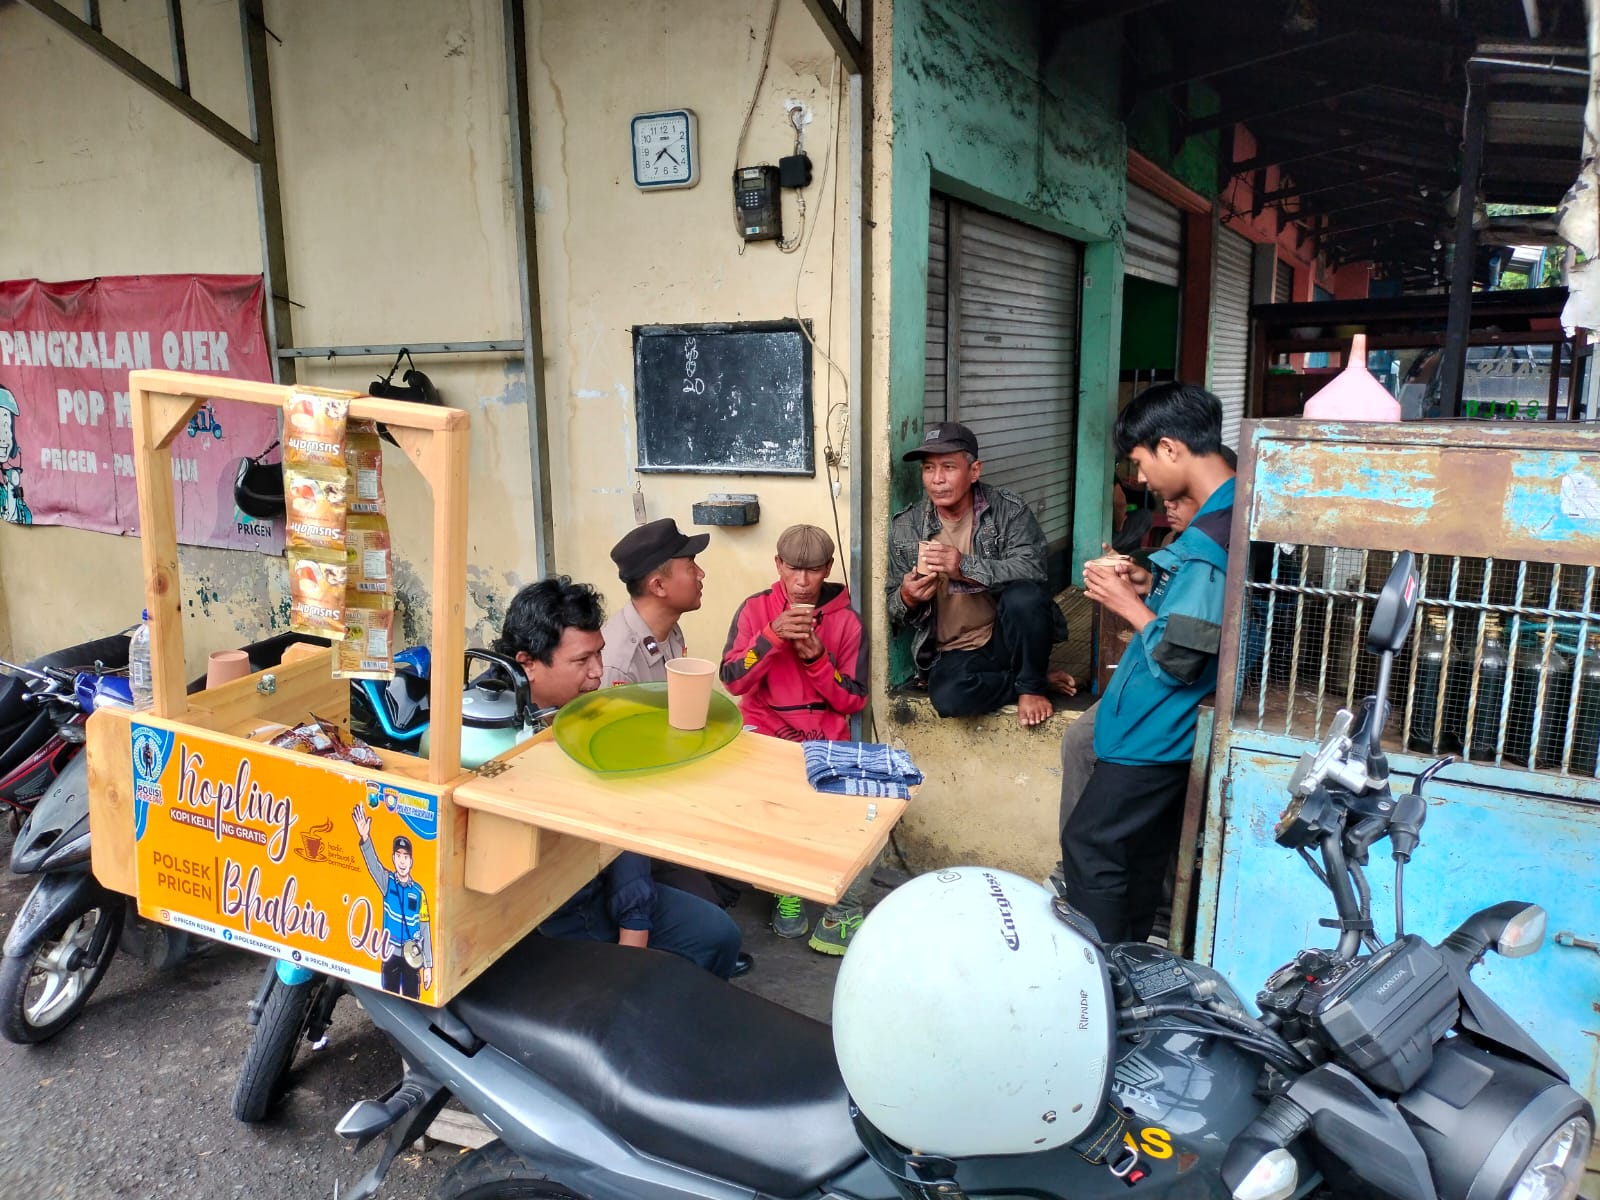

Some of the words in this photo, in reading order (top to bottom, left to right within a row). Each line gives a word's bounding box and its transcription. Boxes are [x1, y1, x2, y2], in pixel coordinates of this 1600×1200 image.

[642, 135, 651, 143] 10
[651, 127, 657, 135] 11
[660, 126, 668, 134] 12
[680, 132, 685, 140] 2
[645, 148, 650, 156] 9
[654, 167, 658, 175] 7
[673, 165, 679, 173] 5
[0, 331, 151, 369] PANGKALAN
[162, 331, 229, 371] OJEK
[57, 389, 104, 425] POP
[41, 448, 97, 473] PRIGEN
[238, 523, 272, 537] PRIGEN
[137, 784, 162, 797] POLISI
[178, 743, 298, 862] Kopling
[170, 809, 190, 823] KOPI
[191, 815, 235, 835] KELILNG
[236, 827, 267, 844] GRATIS
[154, 851, 210, 880] POLSEK
[158, 873, 212, 901] PRIGEN
[222, 859, 329, 940] Bhabin
[982, 873, 1020, 951] Cargloss
[1376, 970, 1406, 995] HONDA
[1111, 1080, 1160, 1110] NDA
